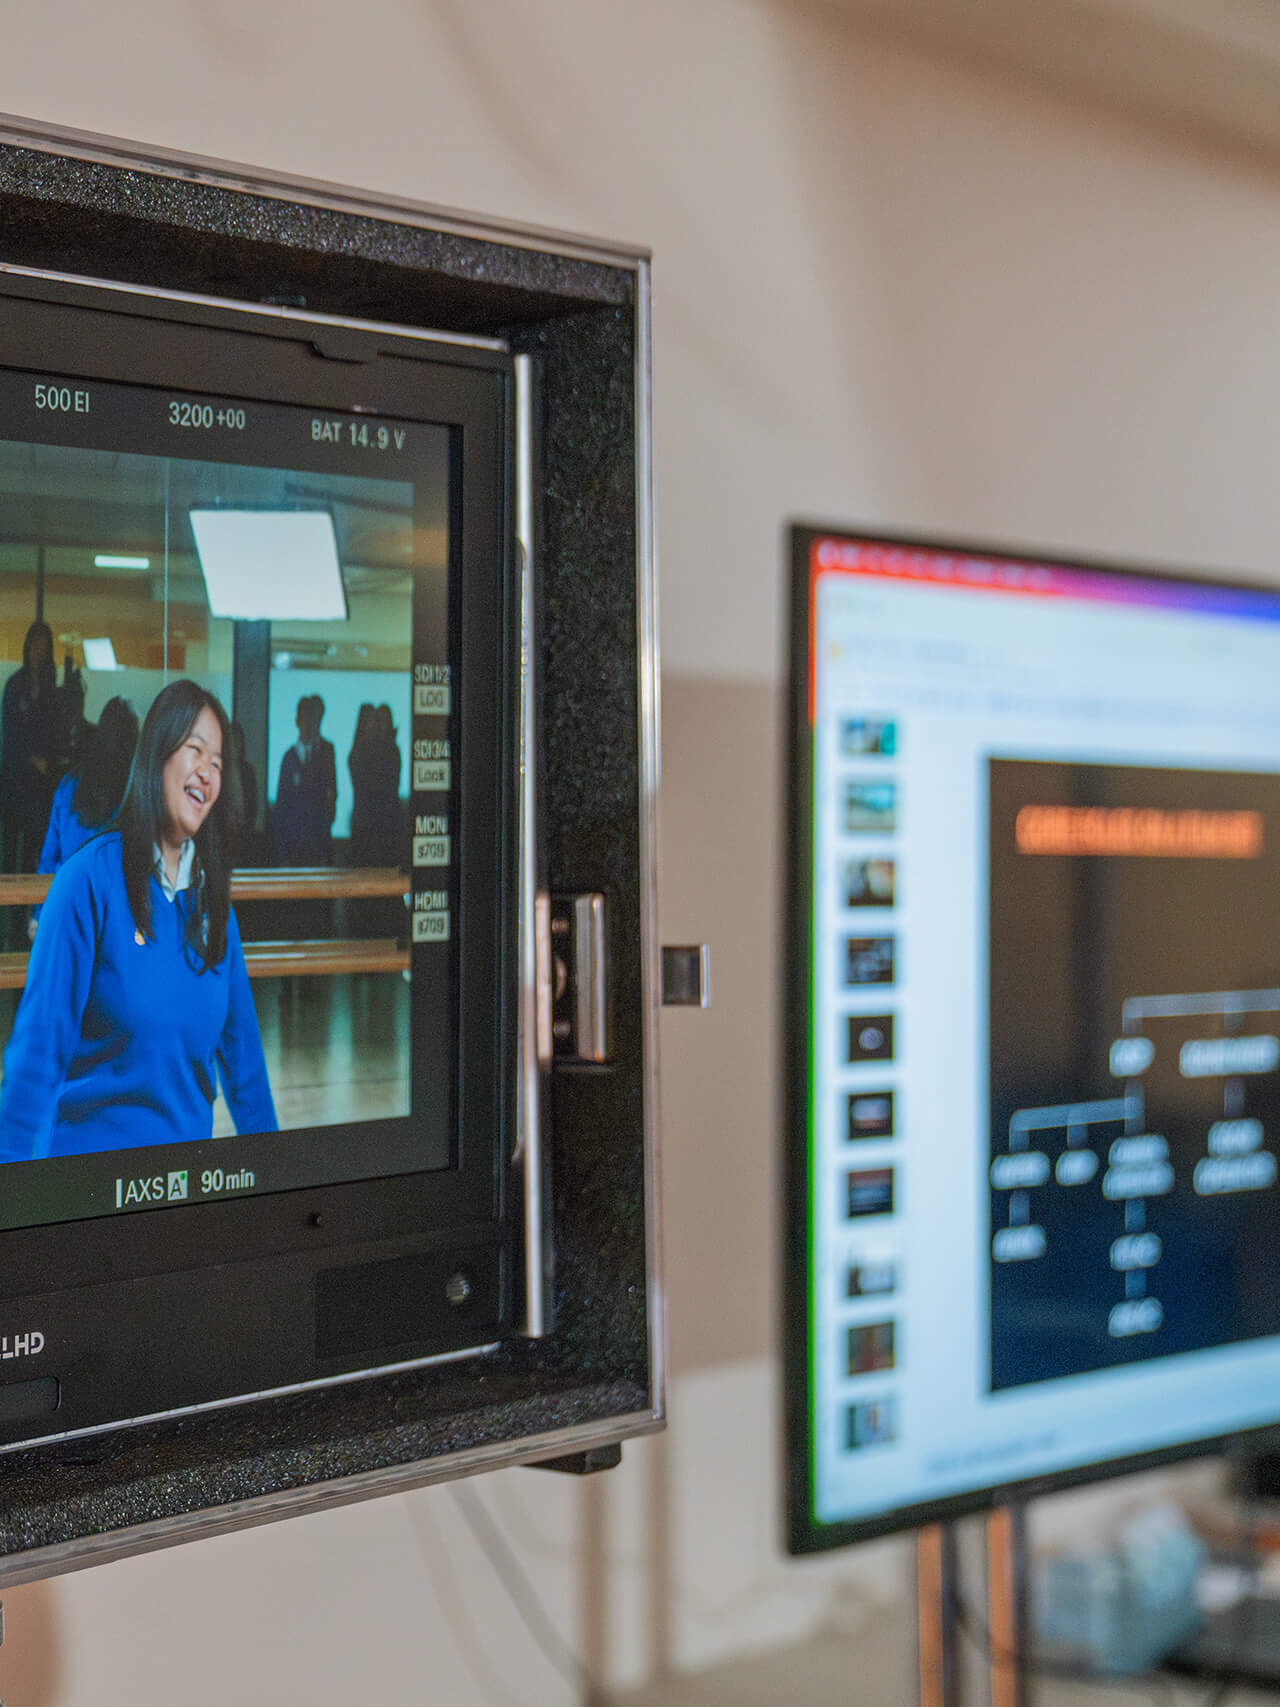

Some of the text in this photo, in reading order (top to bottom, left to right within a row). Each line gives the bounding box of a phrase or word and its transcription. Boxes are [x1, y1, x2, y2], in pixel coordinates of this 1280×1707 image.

[168, 402, 247, 430] 3200+00
[311, 419, 407, 450] BAT 14.9 V
[415, 815, 448, 834] MON
[414, 891, 448, 910] HDMI
[124, 1176, 164, 1205] AXS
